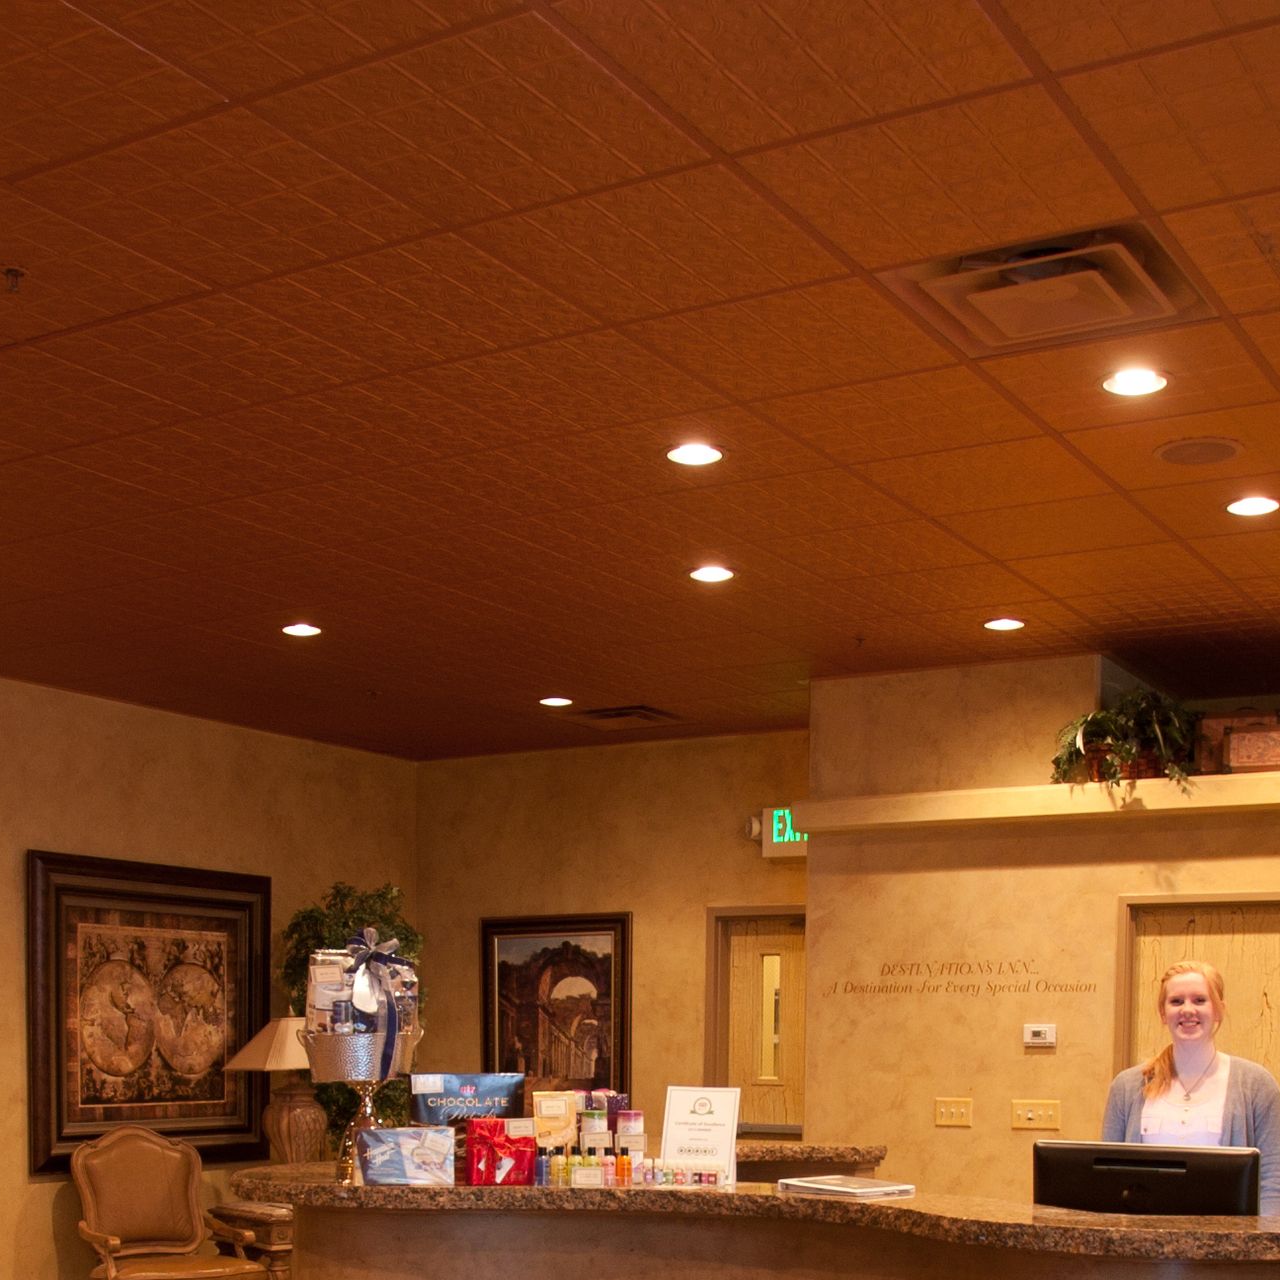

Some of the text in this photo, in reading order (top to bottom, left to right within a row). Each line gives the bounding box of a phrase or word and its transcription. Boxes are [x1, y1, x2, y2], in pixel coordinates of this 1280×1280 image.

[772, 809, 809, 843] EX
[880, 960, 993, 978] DESTINATIONS
[822, 980, 1097, 998] A Destination for Every Special Occasion
[427, 1097, 510, 1107] CHOCOLATE
